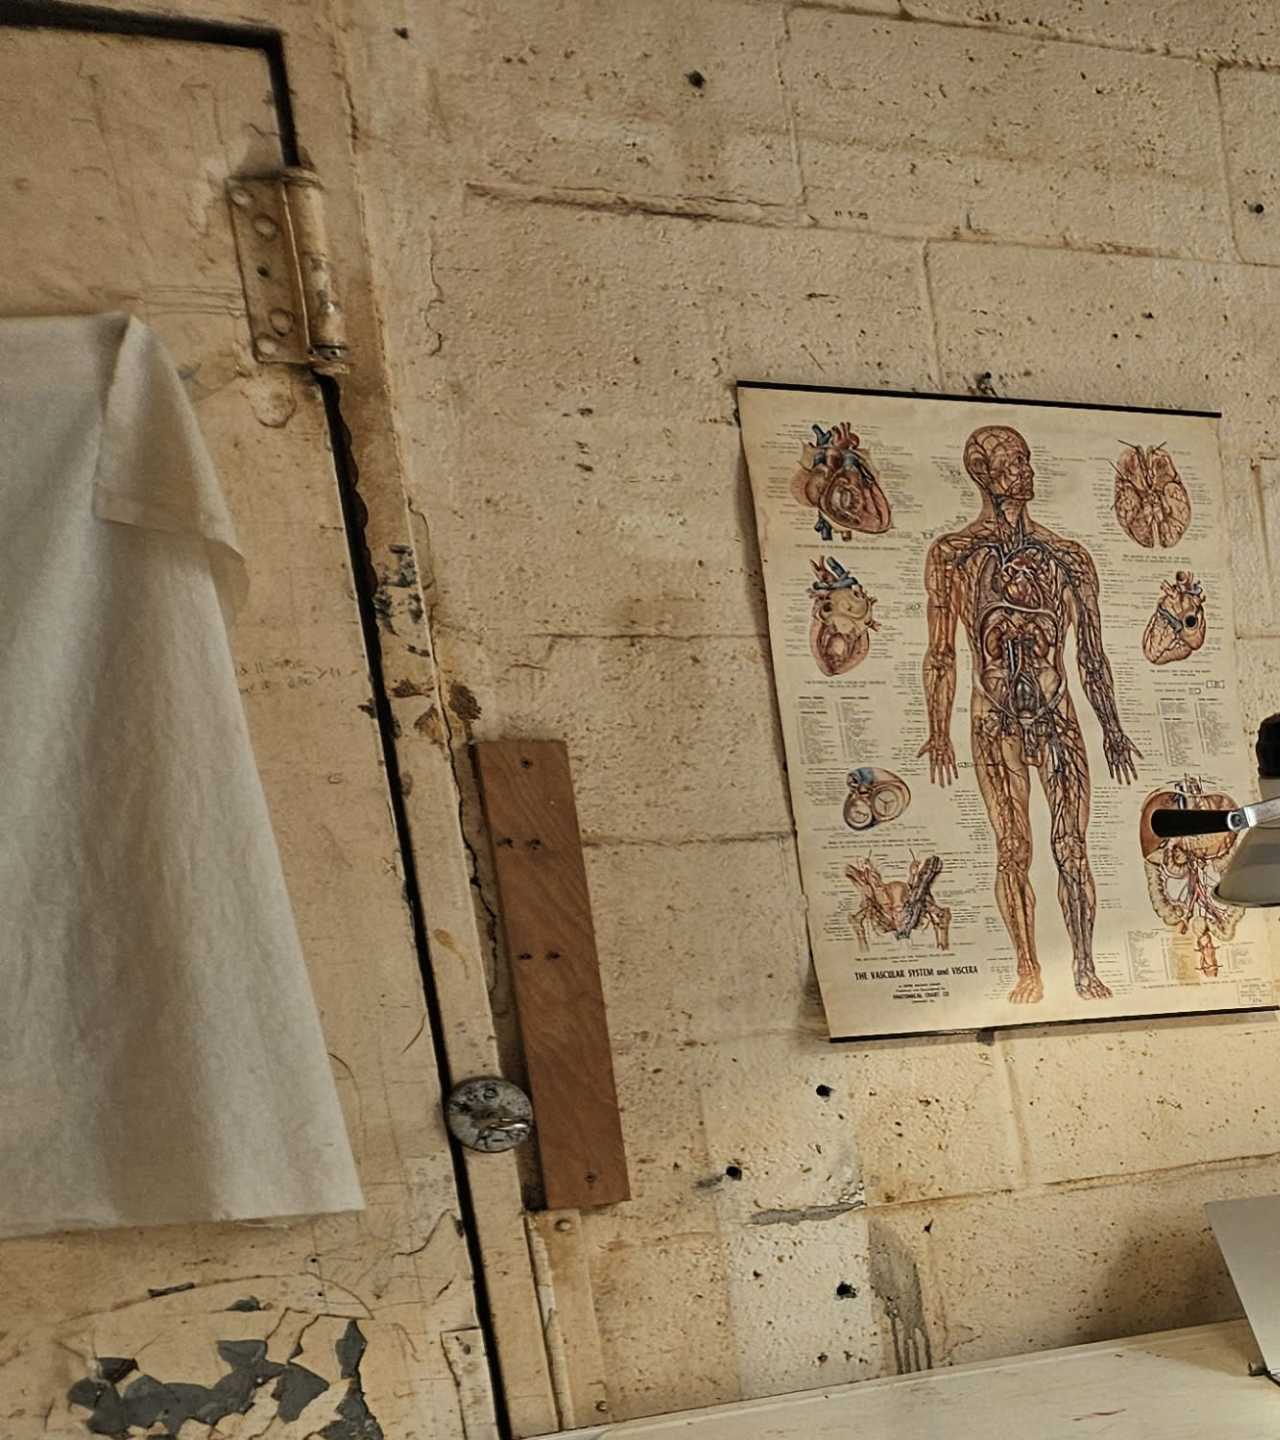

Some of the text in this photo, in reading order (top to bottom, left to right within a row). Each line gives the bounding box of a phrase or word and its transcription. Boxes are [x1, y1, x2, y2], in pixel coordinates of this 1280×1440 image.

[855, 965, 978, 981] THE VASCULAR SYSTEM and VISCERA
